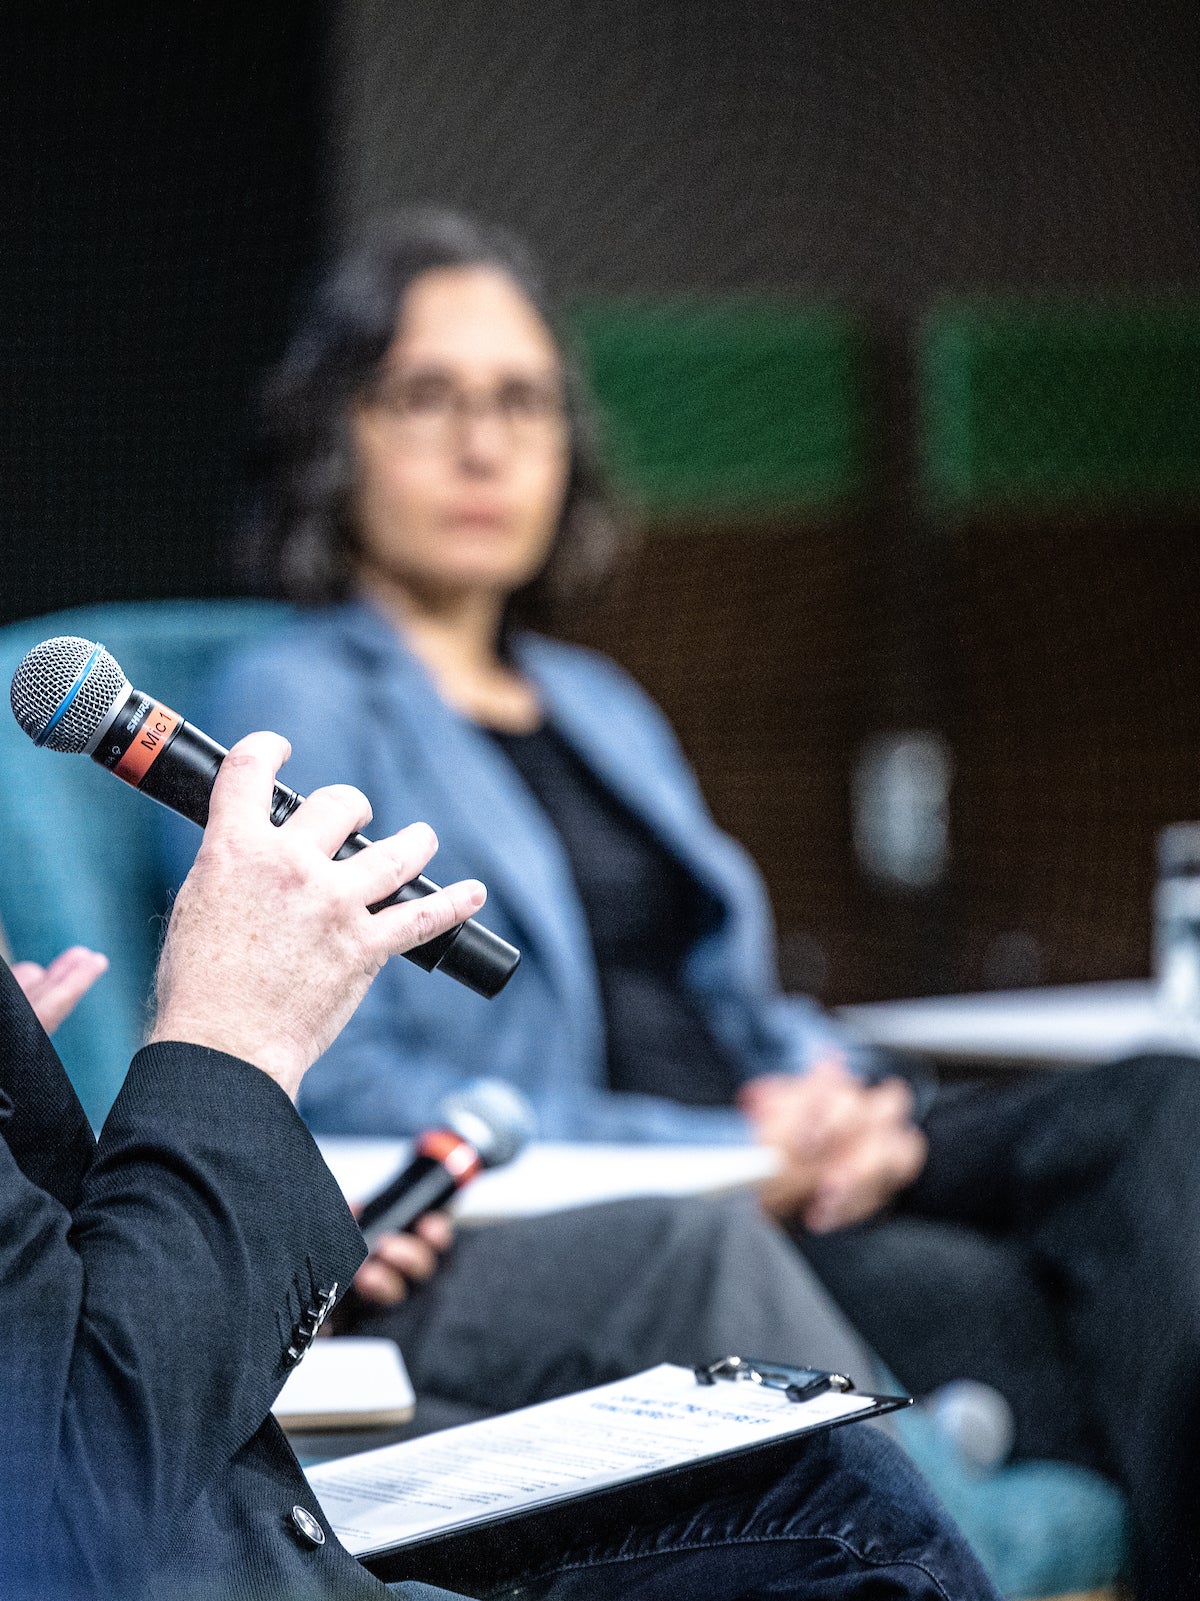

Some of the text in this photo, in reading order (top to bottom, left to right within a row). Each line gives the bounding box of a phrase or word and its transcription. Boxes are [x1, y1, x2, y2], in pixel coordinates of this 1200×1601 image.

[126, 699, 151, 734] SHURE
[140, 711, 172, 751] Mic 1
